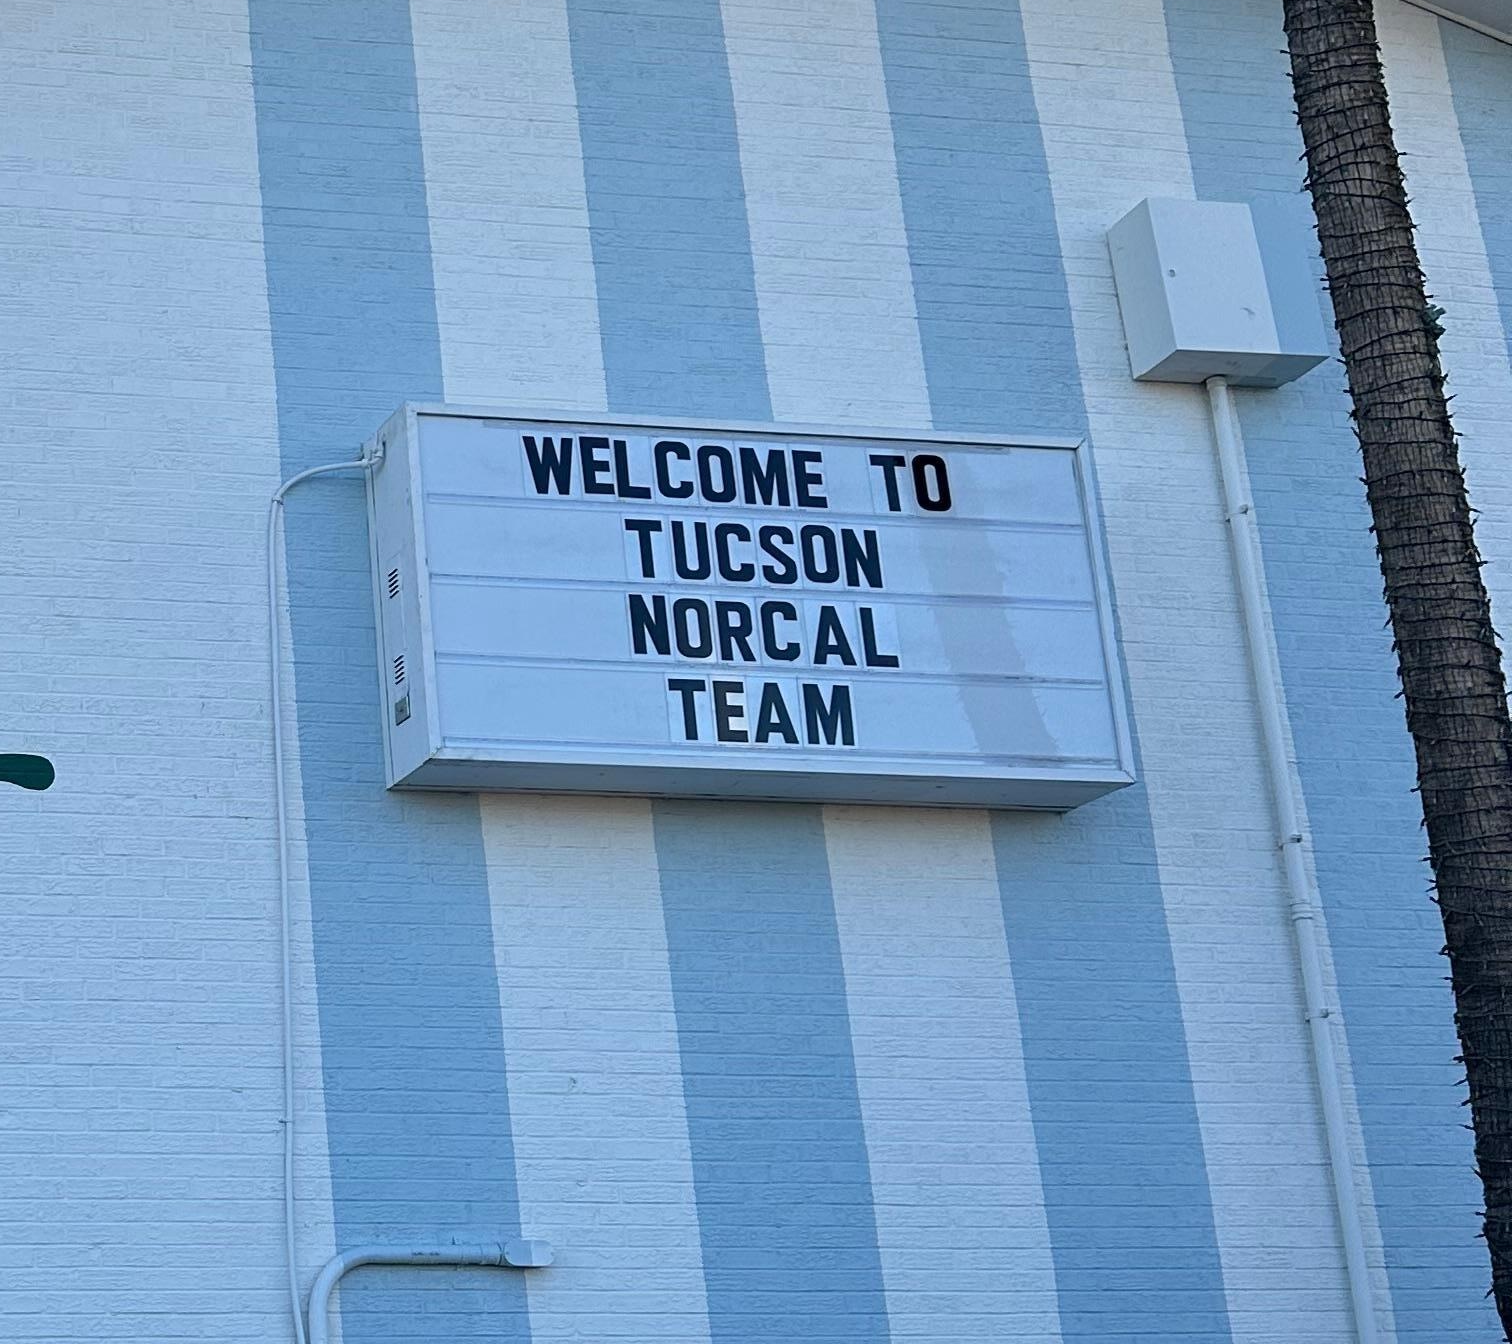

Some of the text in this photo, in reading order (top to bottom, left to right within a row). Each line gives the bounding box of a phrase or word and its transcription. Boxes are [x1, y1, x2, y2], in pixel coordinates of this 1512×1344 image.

[521, 435, 952, 512] WELCOME TO
[624, 518, 884, 589] TUCSON
[628, 593, 900, 668] NORCAL
[667, 678, 855, 746] TEAM
